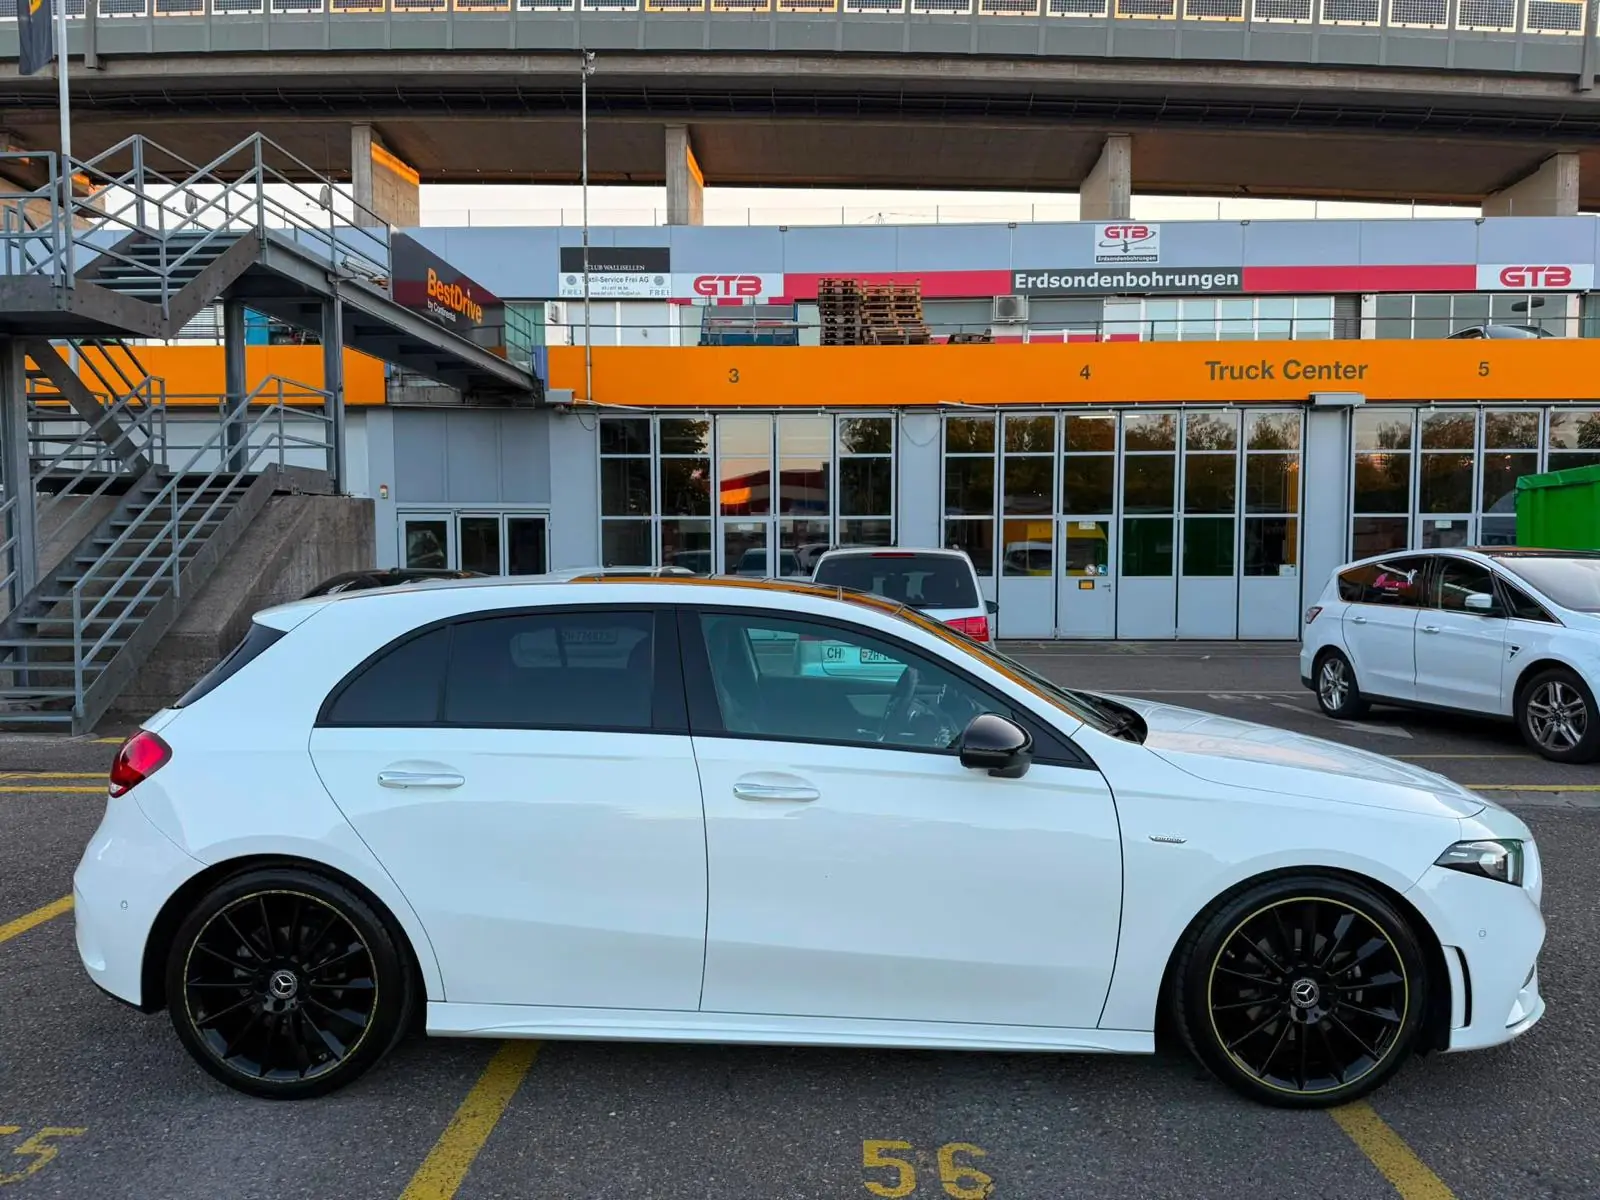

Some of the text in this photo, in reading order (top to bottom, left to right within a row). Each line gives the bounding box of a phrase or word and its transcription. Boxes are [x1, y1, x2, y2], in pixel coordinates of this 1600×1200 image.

[1104, 225, 1148, 239] GTB
[1015, 272, 1239, 289] Erdsondenbohrungen
[1500, 266, 1572, 287] GTB
[693, 275, 762, 296] GTB
[427, 267, 483, 325] BestDrive
[728, 367, 739, 384] 3
[1079, 364, 1091, 380] 4
[1205, 359, 1369, 381] Truck Center
[1478, 361, 1490, 377] 5
[826, 647, 842, 659] CH
[863, 1139, 996, 1200] 56
